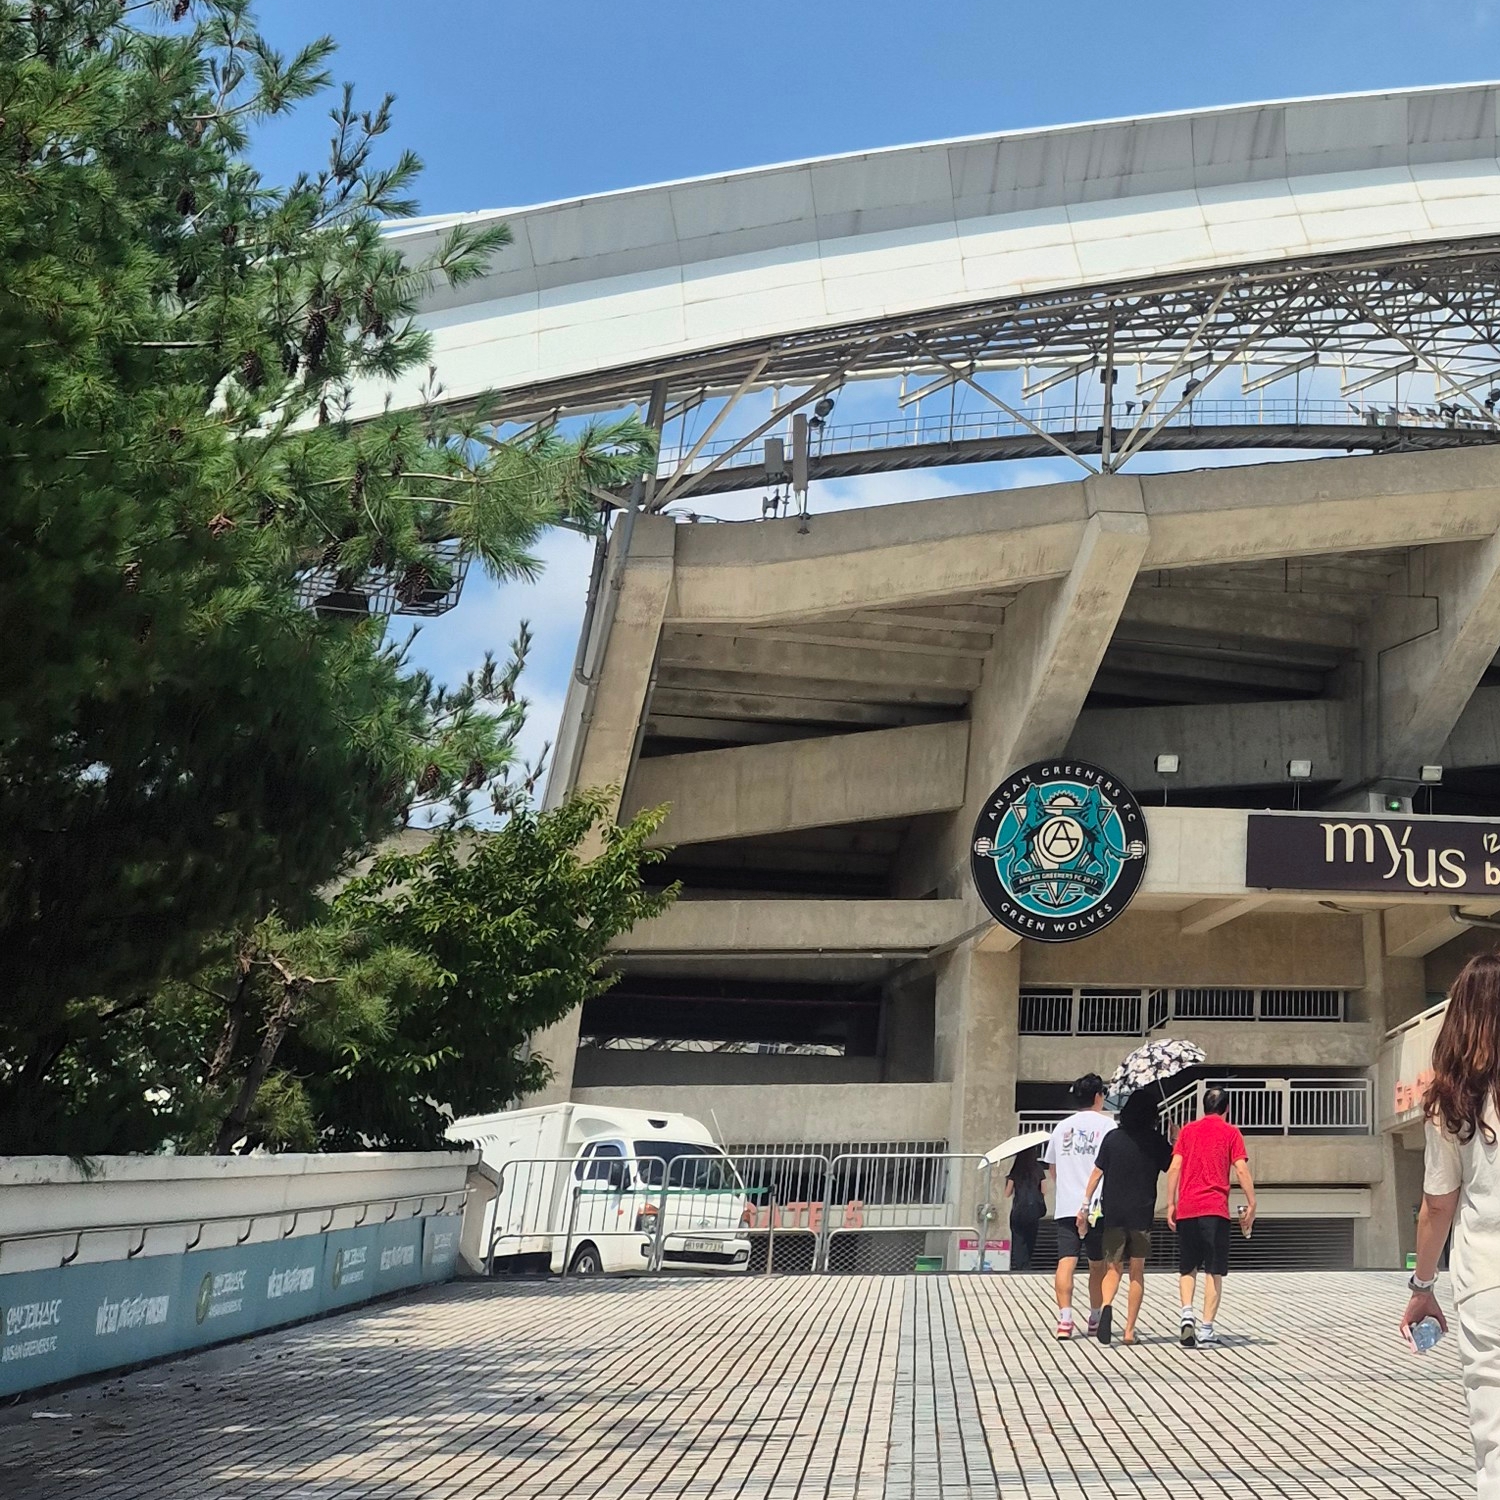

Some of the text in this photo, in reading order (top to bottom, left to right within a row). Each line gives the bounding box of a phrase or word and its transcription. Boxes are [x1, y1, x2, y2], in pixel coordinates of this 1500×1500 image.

[988, 765, 1137, 823] ANSAN GREENERS FC
[1001, 902, 1113, 933] GREEN WOLVES
